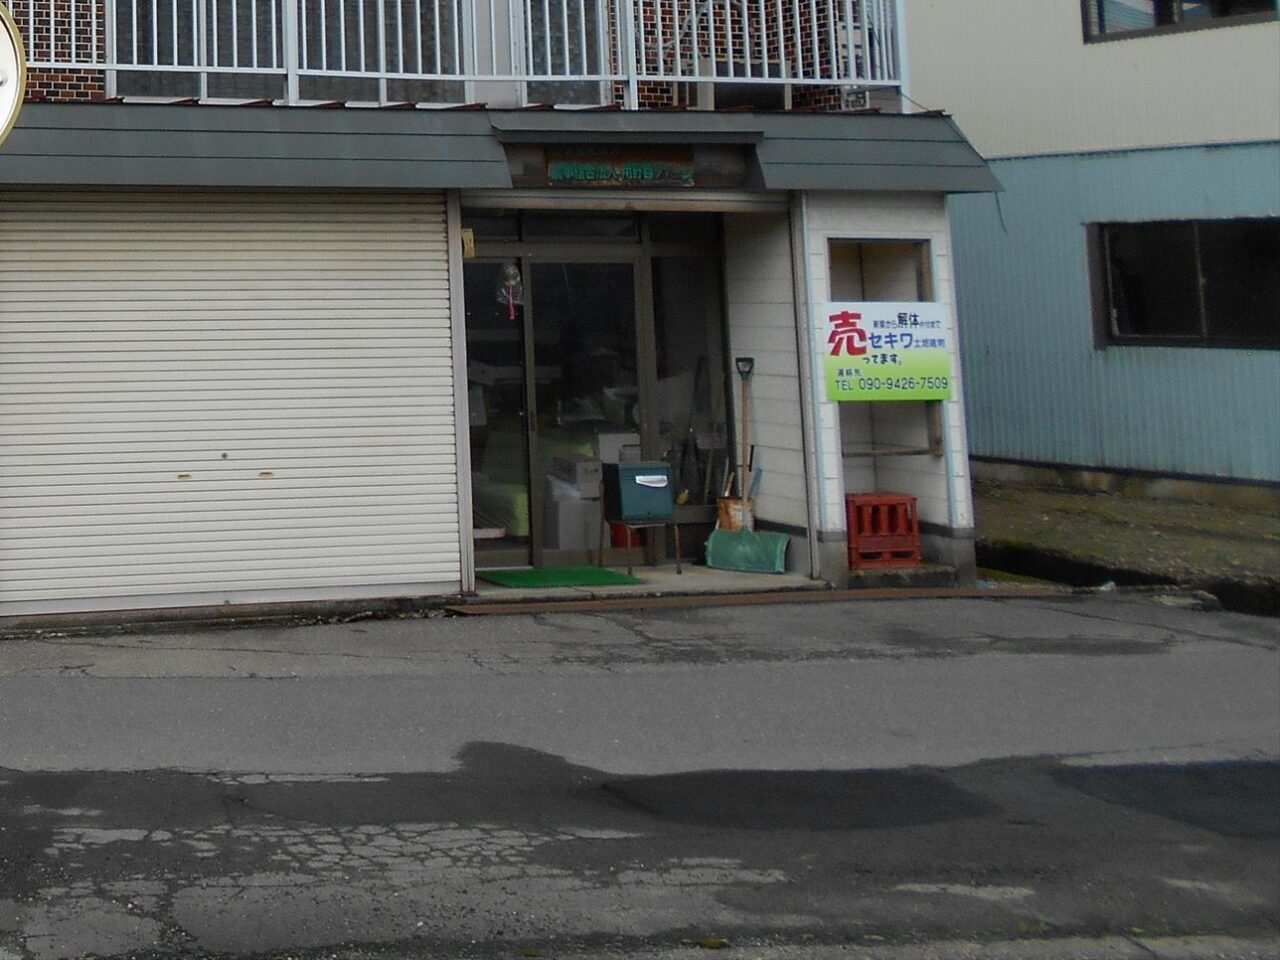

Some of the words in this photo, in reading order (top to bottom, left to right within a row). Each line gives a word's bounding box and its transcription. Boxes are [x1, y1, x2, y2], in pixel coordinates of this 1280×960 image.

[827, 310, 867, 356] 売
[835, 380, 854, 391] TEL
[859, 377, 948, 390] 090-9426-7509
